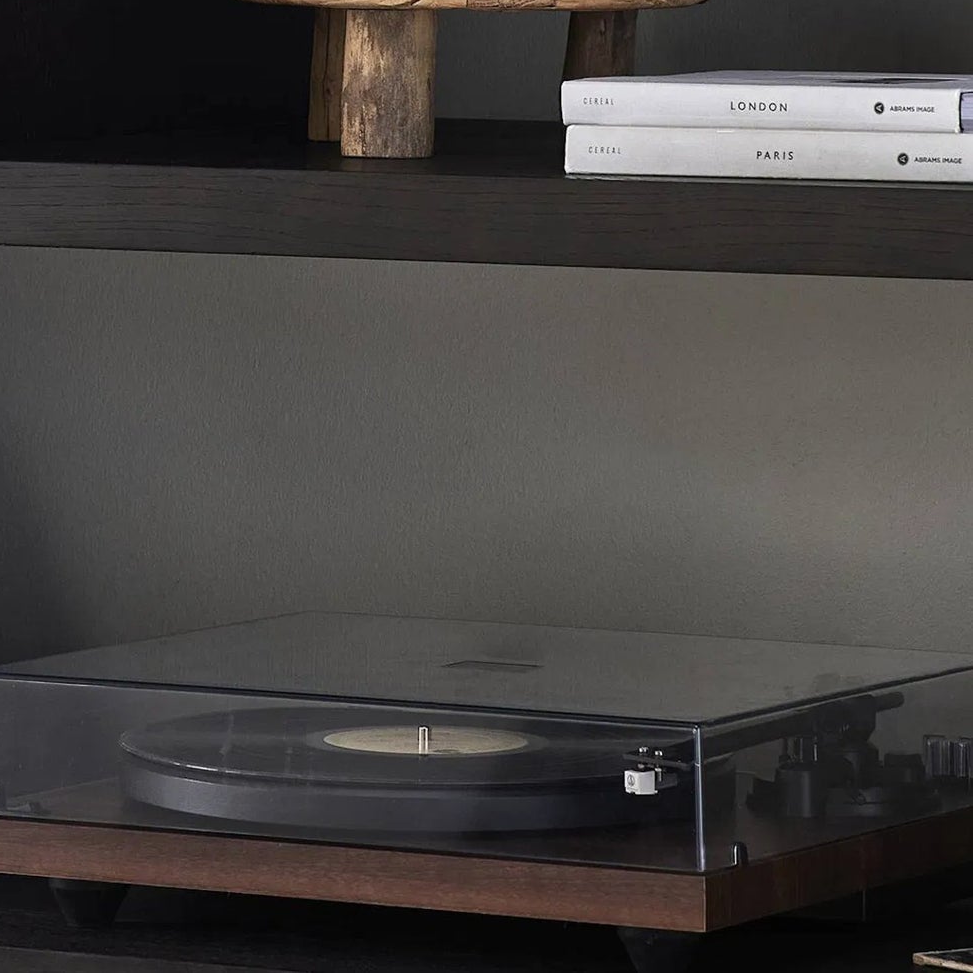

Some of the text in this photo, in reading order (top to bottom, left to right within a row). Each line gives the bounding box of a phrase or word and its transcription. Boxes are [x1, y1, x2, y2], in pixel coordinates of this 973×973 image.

[583, 97, 614, 106] CEREAL
[730, 101, 788, 112] LONDON
[588, 146, 621, 155] CEREAL
[756, 151, 794, 160] PARIS
